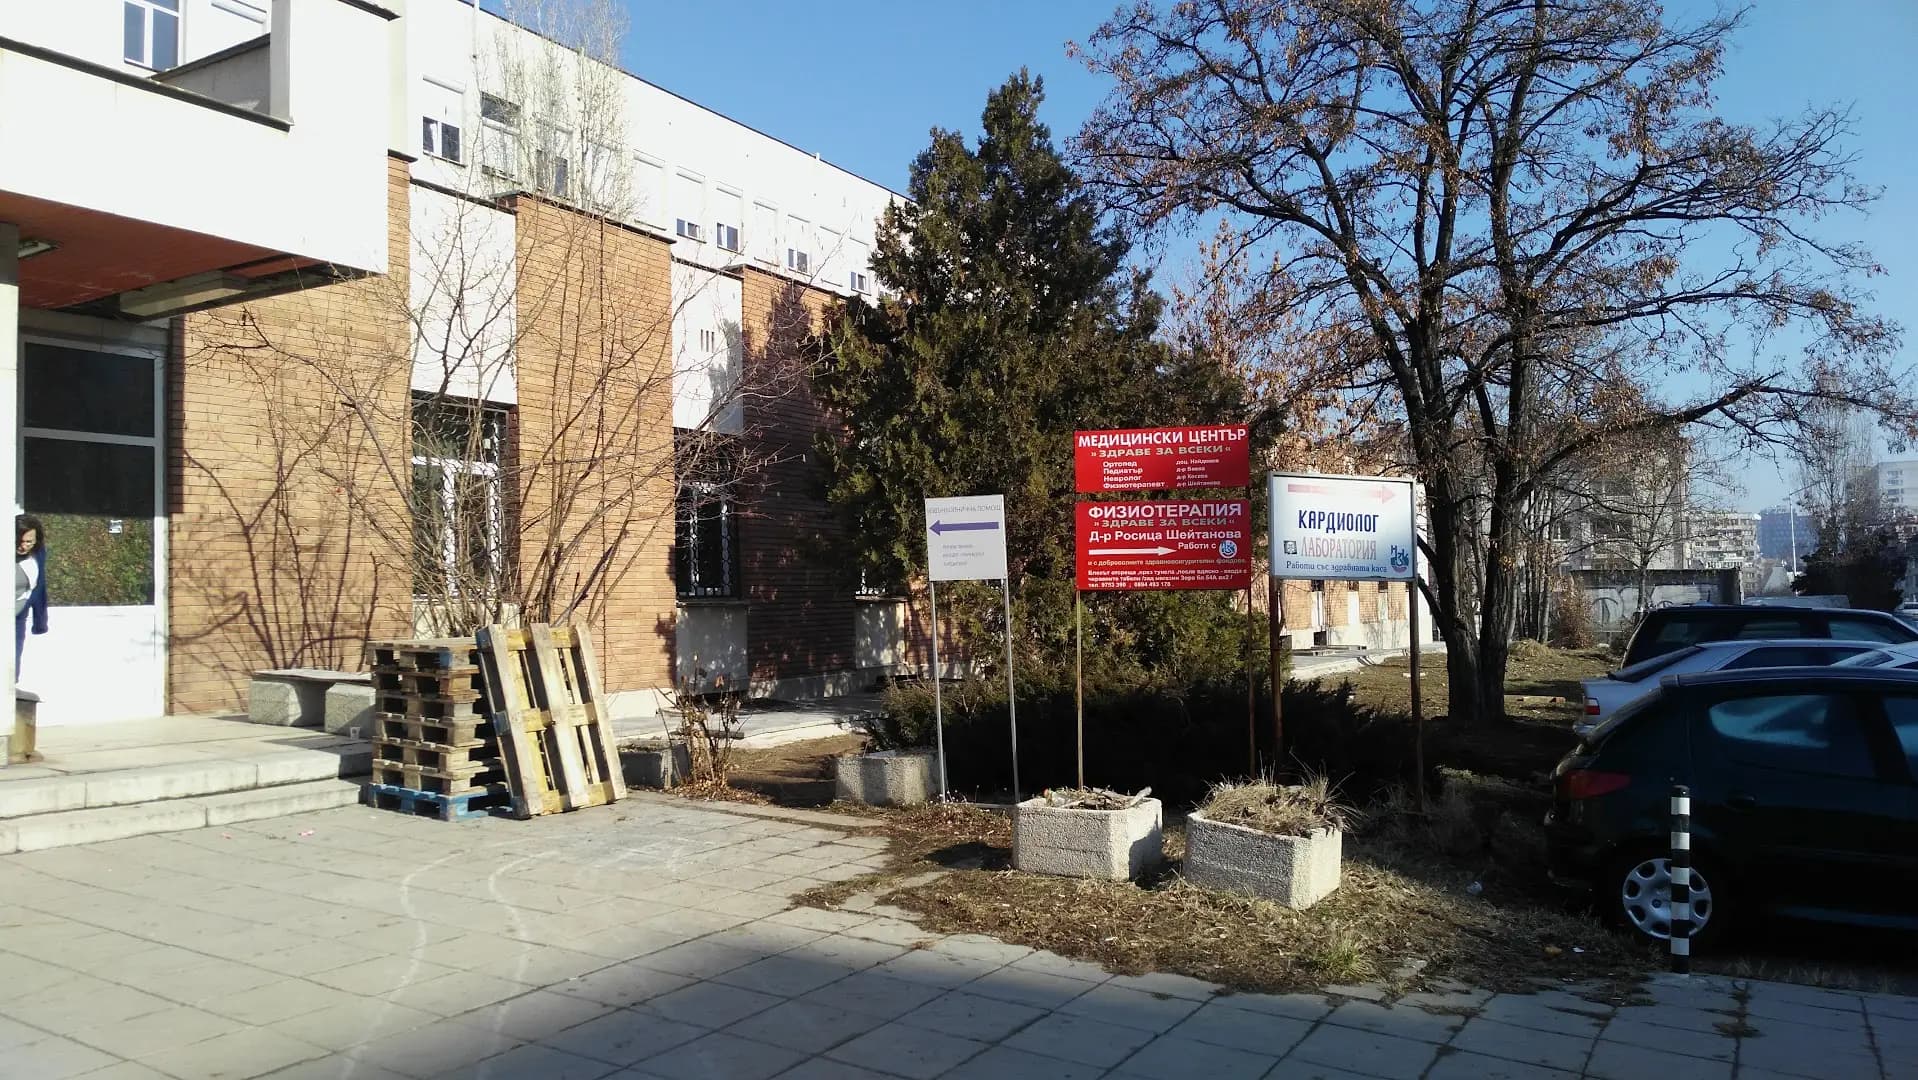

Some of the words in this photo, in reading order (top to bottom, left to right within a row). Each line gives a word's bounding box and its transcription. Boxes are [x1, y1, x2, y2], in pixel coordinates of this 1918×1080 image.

[1078, 432, 1183, 448] МЕДИЦИНСКИ
[1189, 428, 1247, 444] ЦЕНТЪР
[1099, 448, 1151, 458] ЗДРАВЕ
[1156, 447, 1174, 455] ЗА
[1178, 445, 1223, 454] ВСЕКИ
[1088, 504, 1242, 519] ФИЗИОТЕРАПИЯ
[1102, 519, 1154, 528] ЗДРАВЕ
[1182, 518, 1226, 526] ВСЕКИ
[1298, 510, 1379, 533] КАРДИОЛОГ
[1089, 531, 1112, 543] Д-р
[1115, 530, 1162, 542] Росица
[1166, 529, 1242, 540] Шейтанова
[1178, 542, 1209, 550] Работи
[1300, 537, 1377, 560] ЛАБОРАТОРИЯ
[1286, 561, 1315, 570] Работи
[1371, 564, 1387, 573] каса
